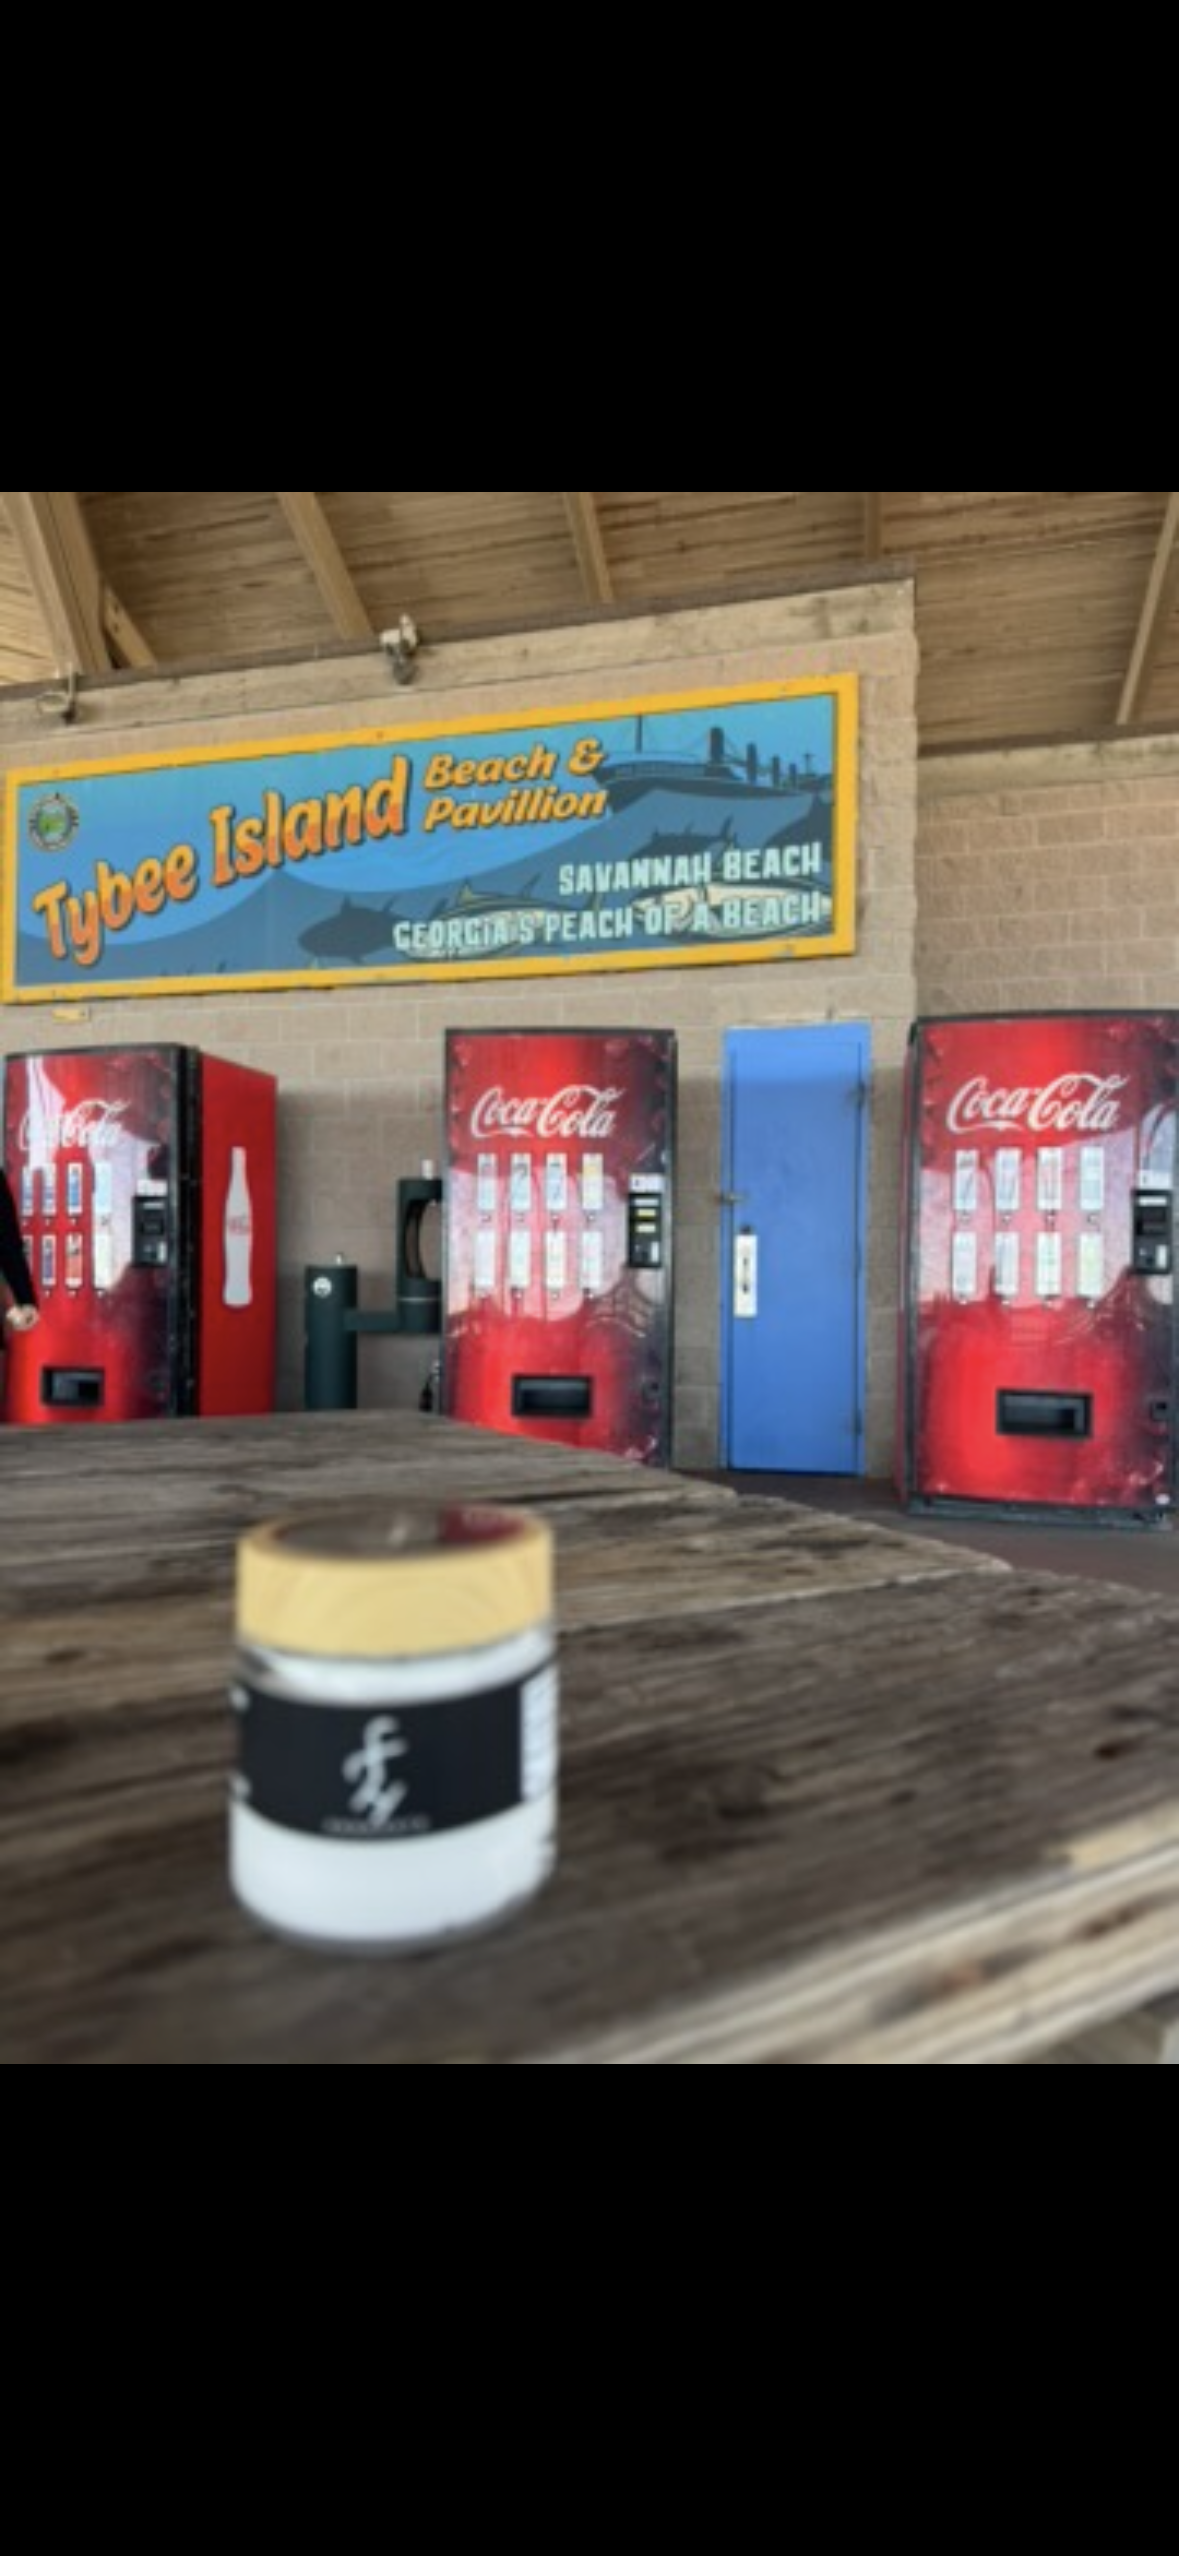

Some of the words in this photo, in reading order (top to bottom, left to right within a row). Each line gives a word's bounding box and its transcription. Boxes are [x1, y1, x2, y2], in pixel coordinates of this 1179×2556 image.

[423, 740, 556, 788] Beach
[567, 737, 606, 775] &
[423, 786, 607, 831] Pavillion
[33, 843, 198, 968] Tybee
[209, 753, 411, 888] Island
[559, 853, 710, 896] SAVANNAH
[723, 842, 821, 881] BEACH
[545, 906, 632, 941] PEACH
[646, 901, 681, 934] OF
[692, 900, 711, 931] A
[722, 891, 821, 928] BEACH
[471, 1084, 625, 1138] Coca-Cola
[947, 1073, 1129, 1133] Coca-Cola
